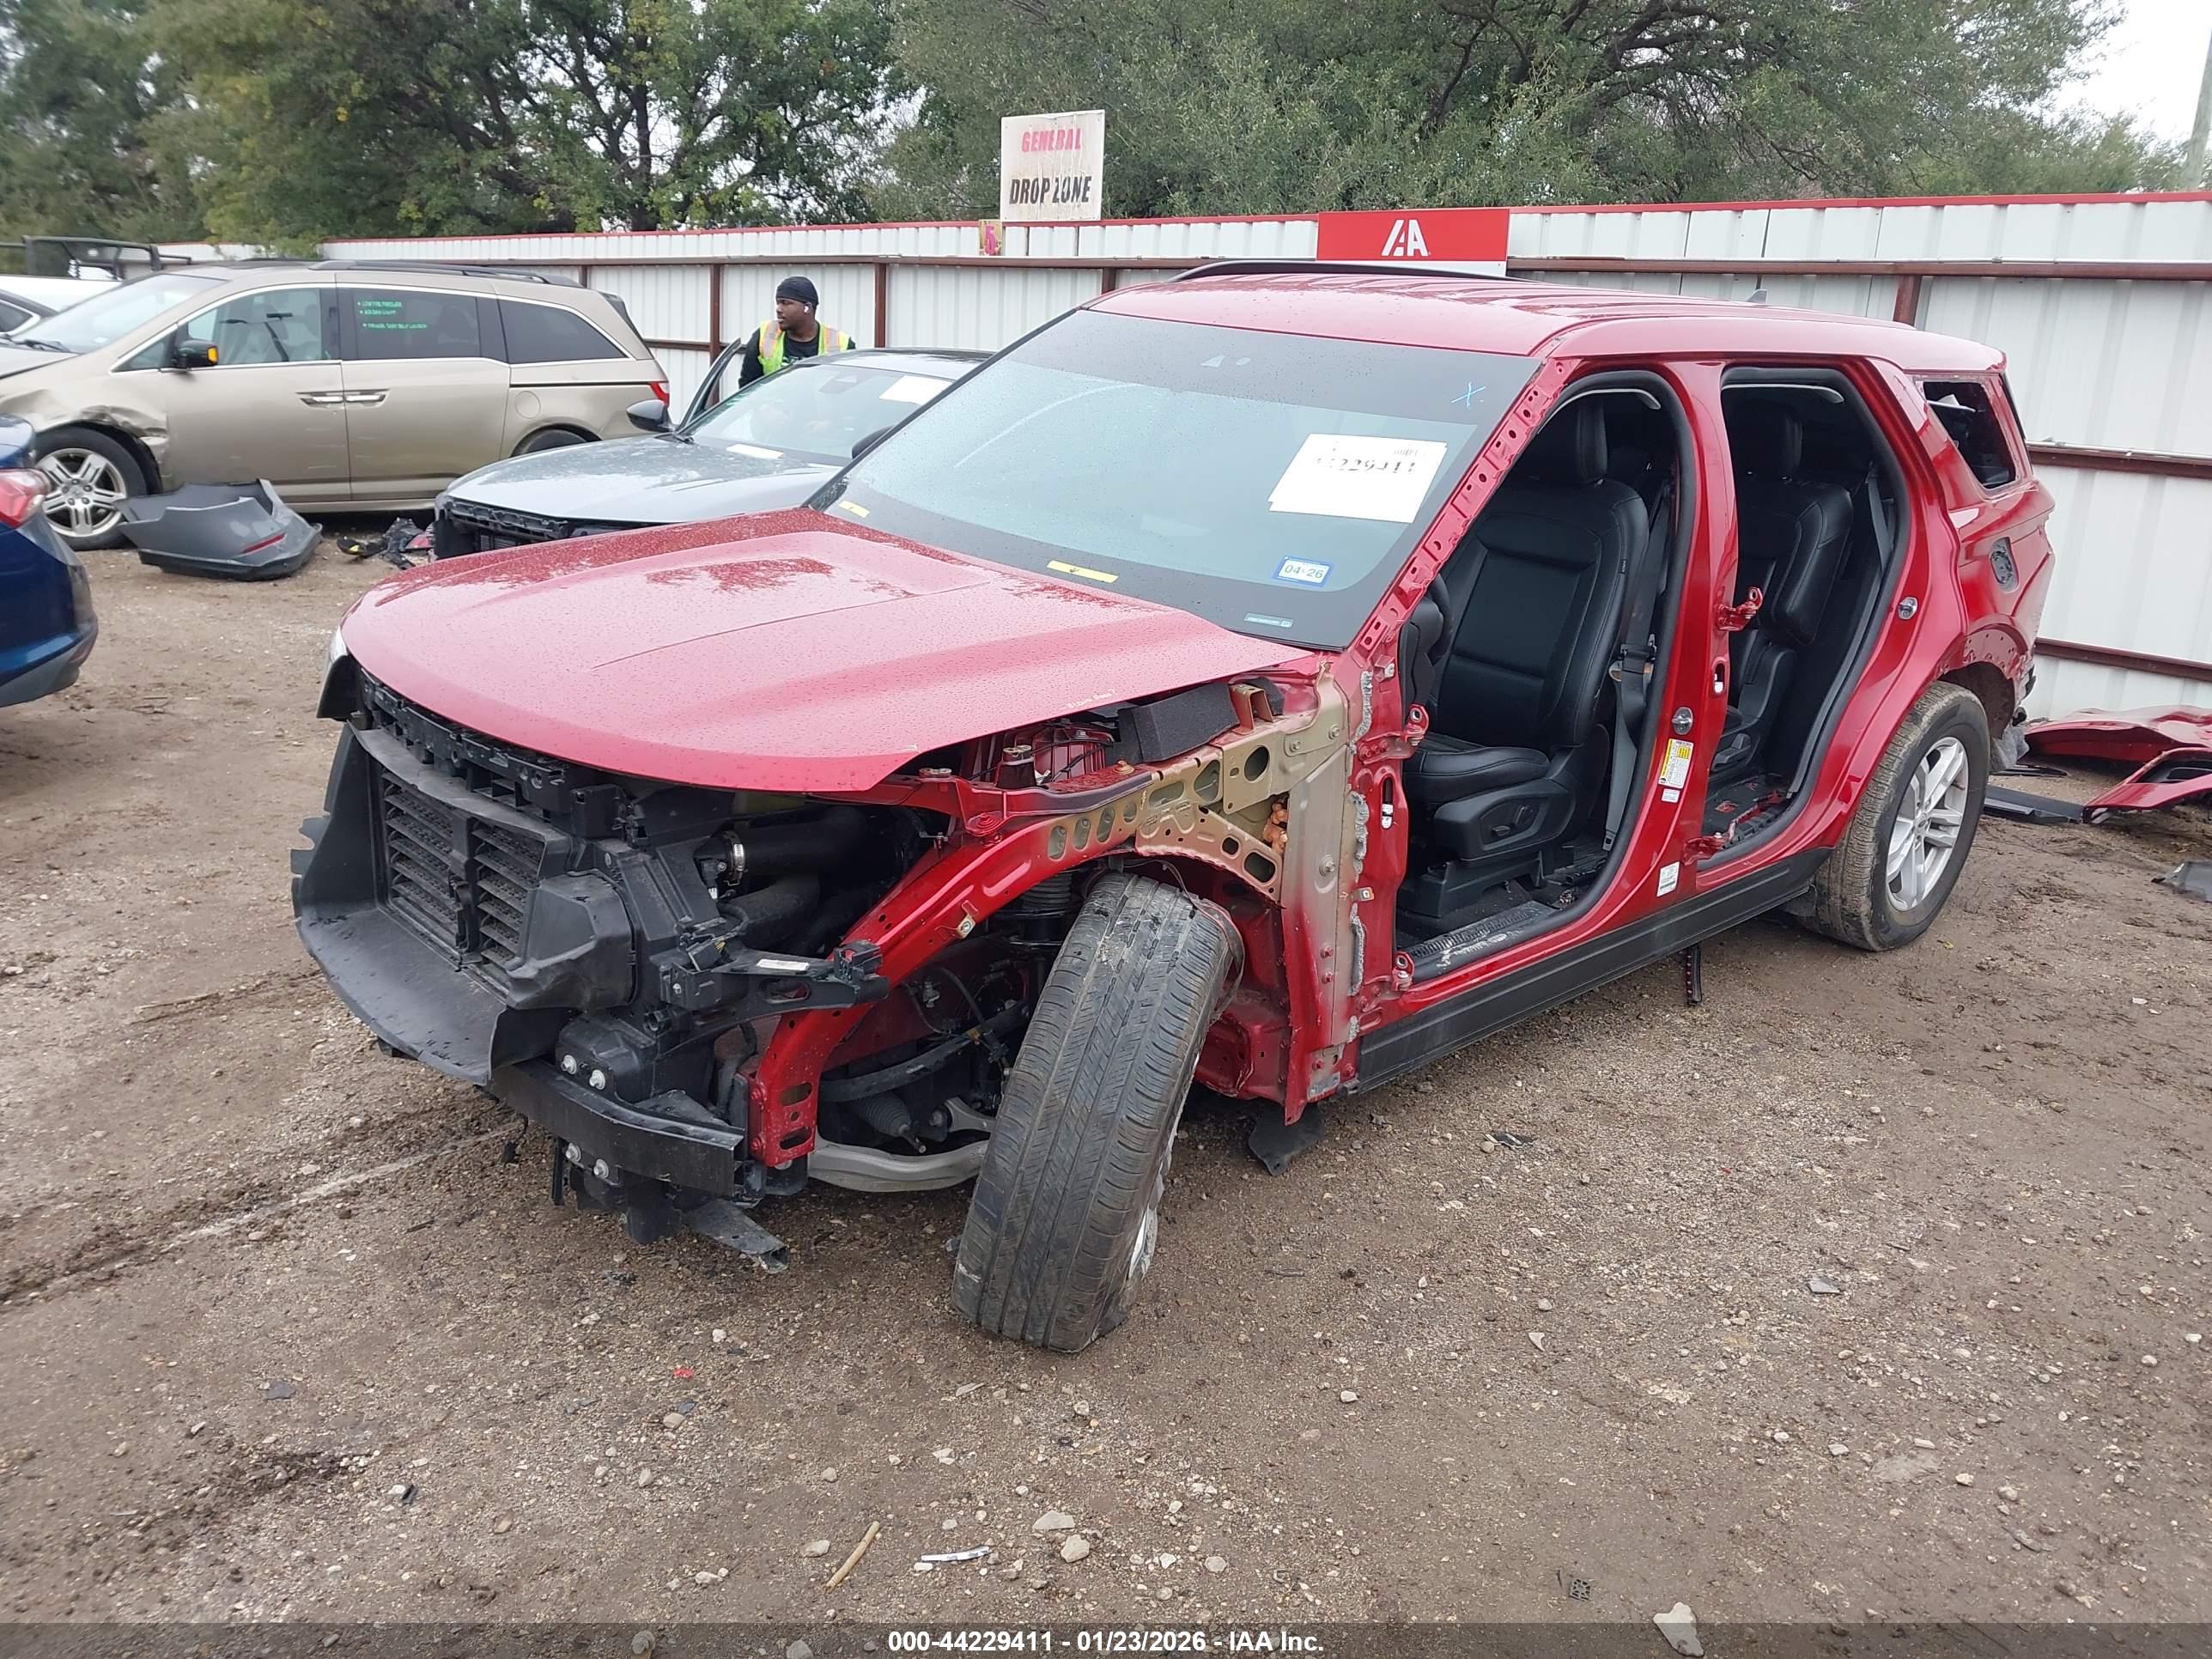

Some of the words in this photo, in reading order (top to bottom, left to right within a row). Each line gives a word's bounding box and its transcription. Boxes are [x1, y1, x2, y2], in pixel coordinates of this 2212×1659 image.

[1022, 129, 1082, 153] GENERAL
[1009, 177, 1051, 204] DROP
[1052, 175, 1092, 204] ZONE
